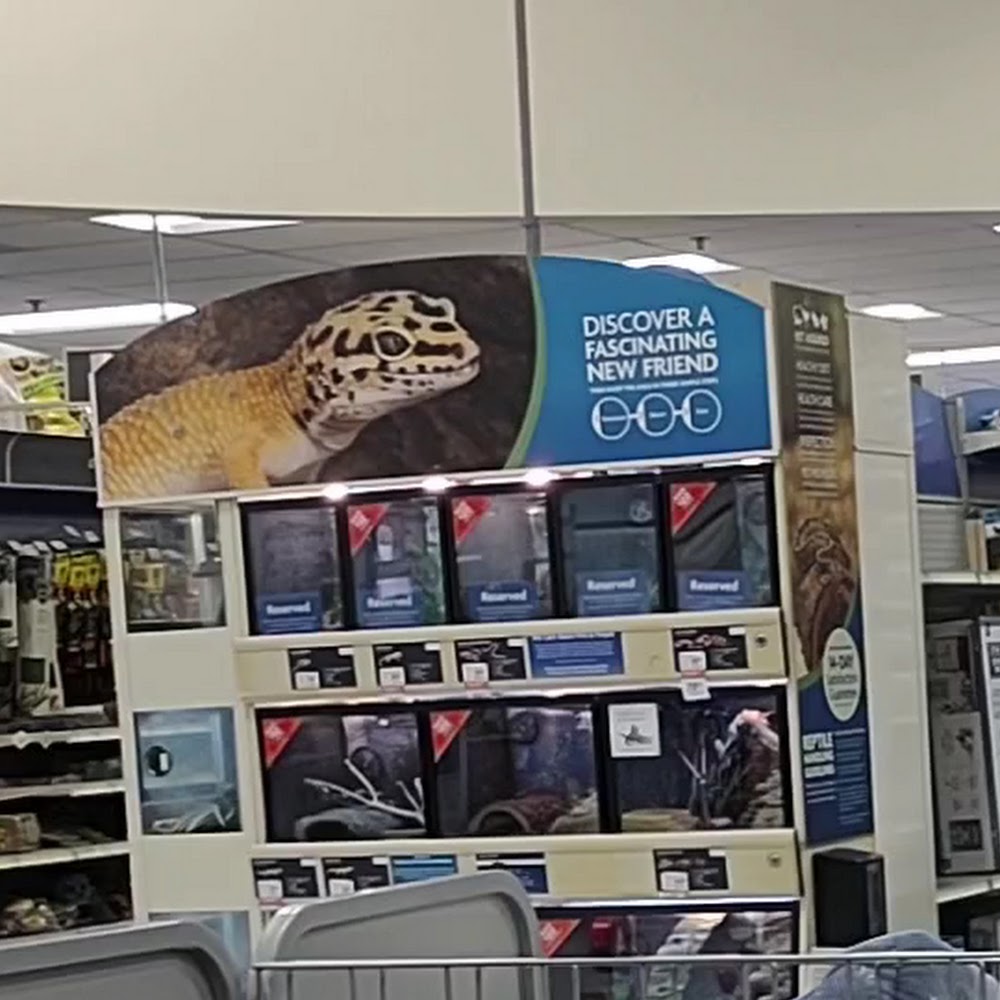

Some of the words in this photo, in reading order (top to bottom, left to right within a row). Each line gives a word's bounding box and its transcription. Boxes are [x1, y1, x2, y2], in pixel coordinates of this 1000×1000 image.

[583, 307, 693, 337] DISCOVER
[698, 305, 715, 327] A
[585, 330, 718, 360] FASCINATING
[586, 359, 638, 383] NEW
[642, 352, 719, 378] FRIEND
